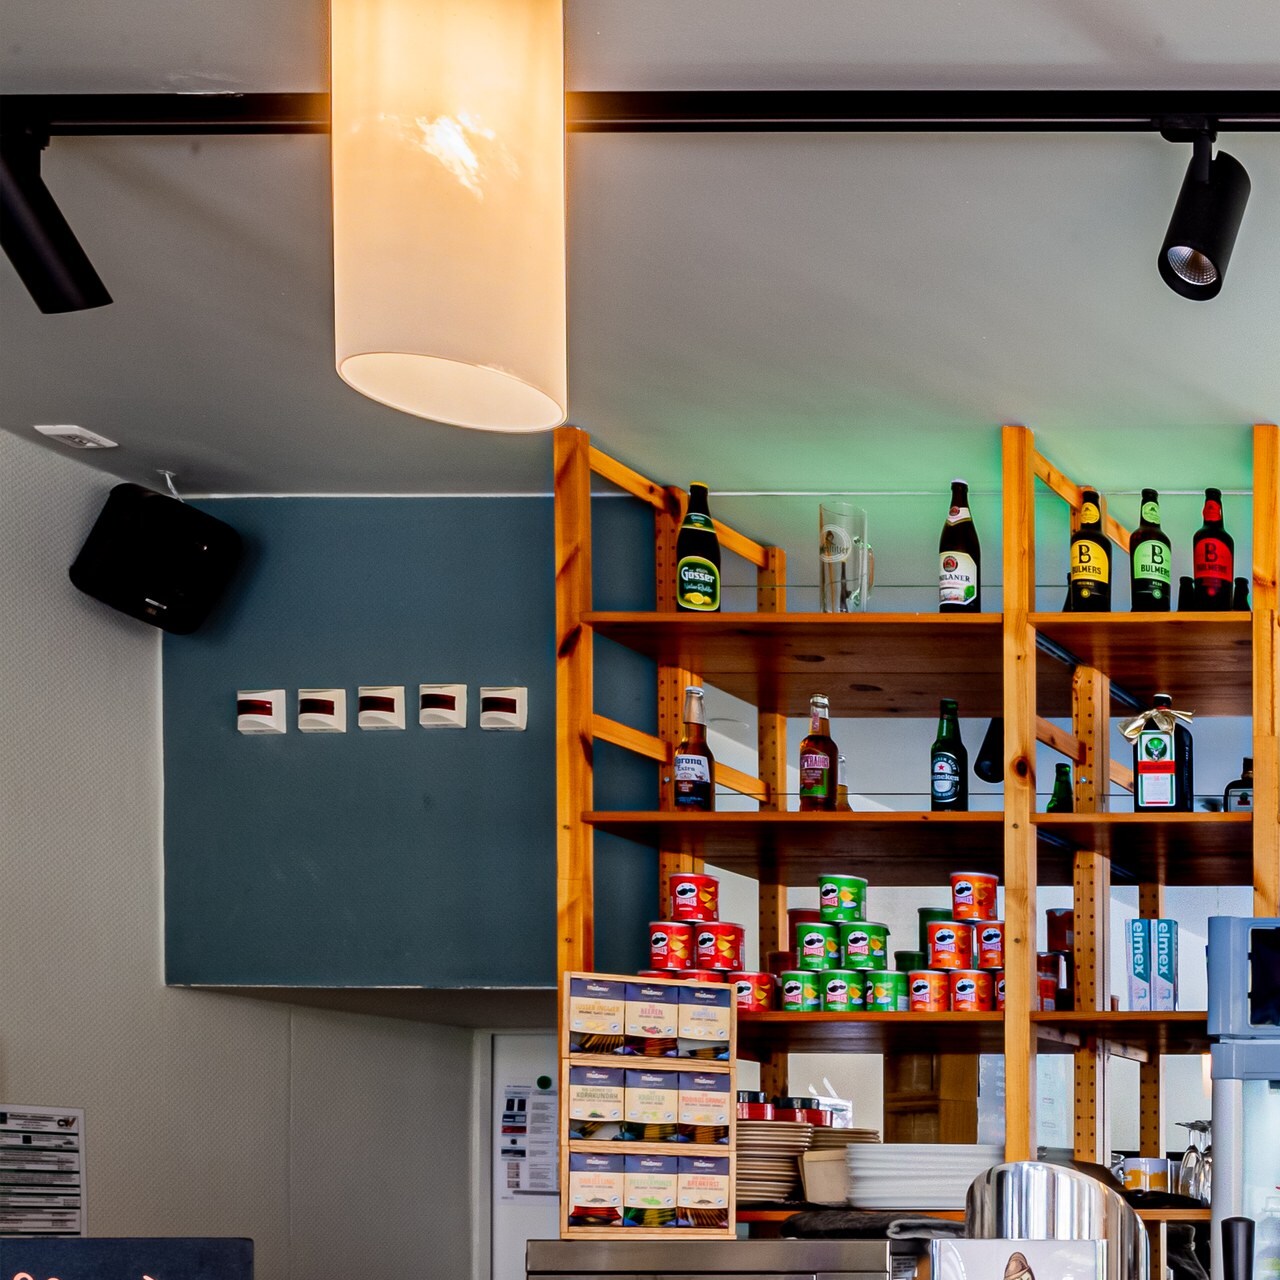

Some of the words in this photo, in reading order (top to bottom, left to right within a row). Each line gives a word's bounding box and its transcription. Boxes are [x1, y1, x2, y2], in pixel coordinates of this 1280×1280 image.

[1072, 564, 1102, 575] BULMERS
[1140, 563, 1170, 576] BULMERS
[1131, 921, 1145, 976] elmex
[1157, 921, 1170, 976] elmex
